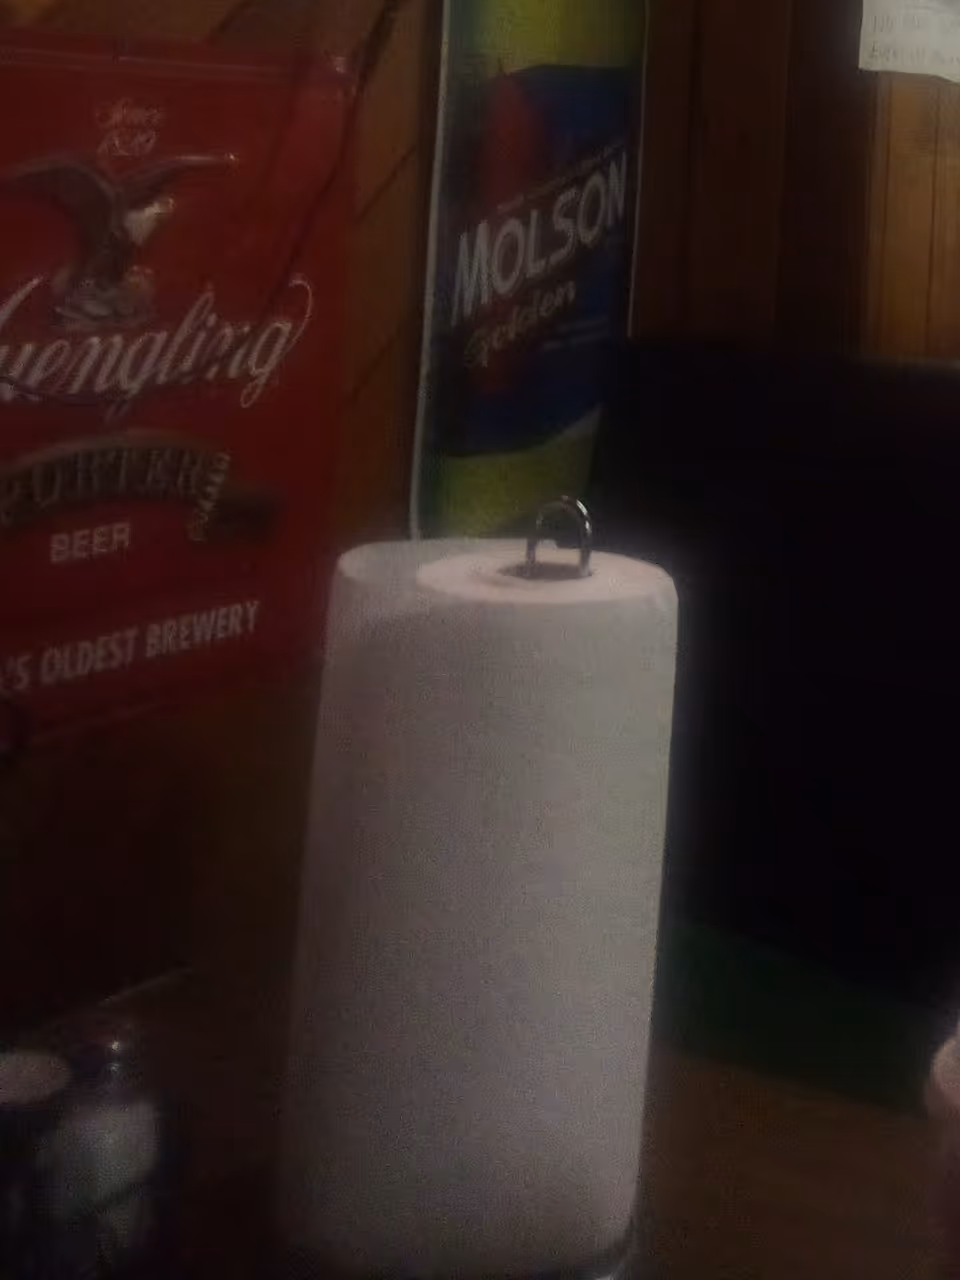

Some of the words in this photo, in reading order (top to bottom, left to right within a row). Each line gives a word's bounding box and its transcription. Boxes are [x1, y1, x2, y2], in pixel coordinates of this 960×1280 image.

[450, 150, 628, 329] MOLSON
[49, 520, 132, 564] BEER
[37, 626, 140, 688] OLDEST
[144, 597, 261, 659] BREWERY
